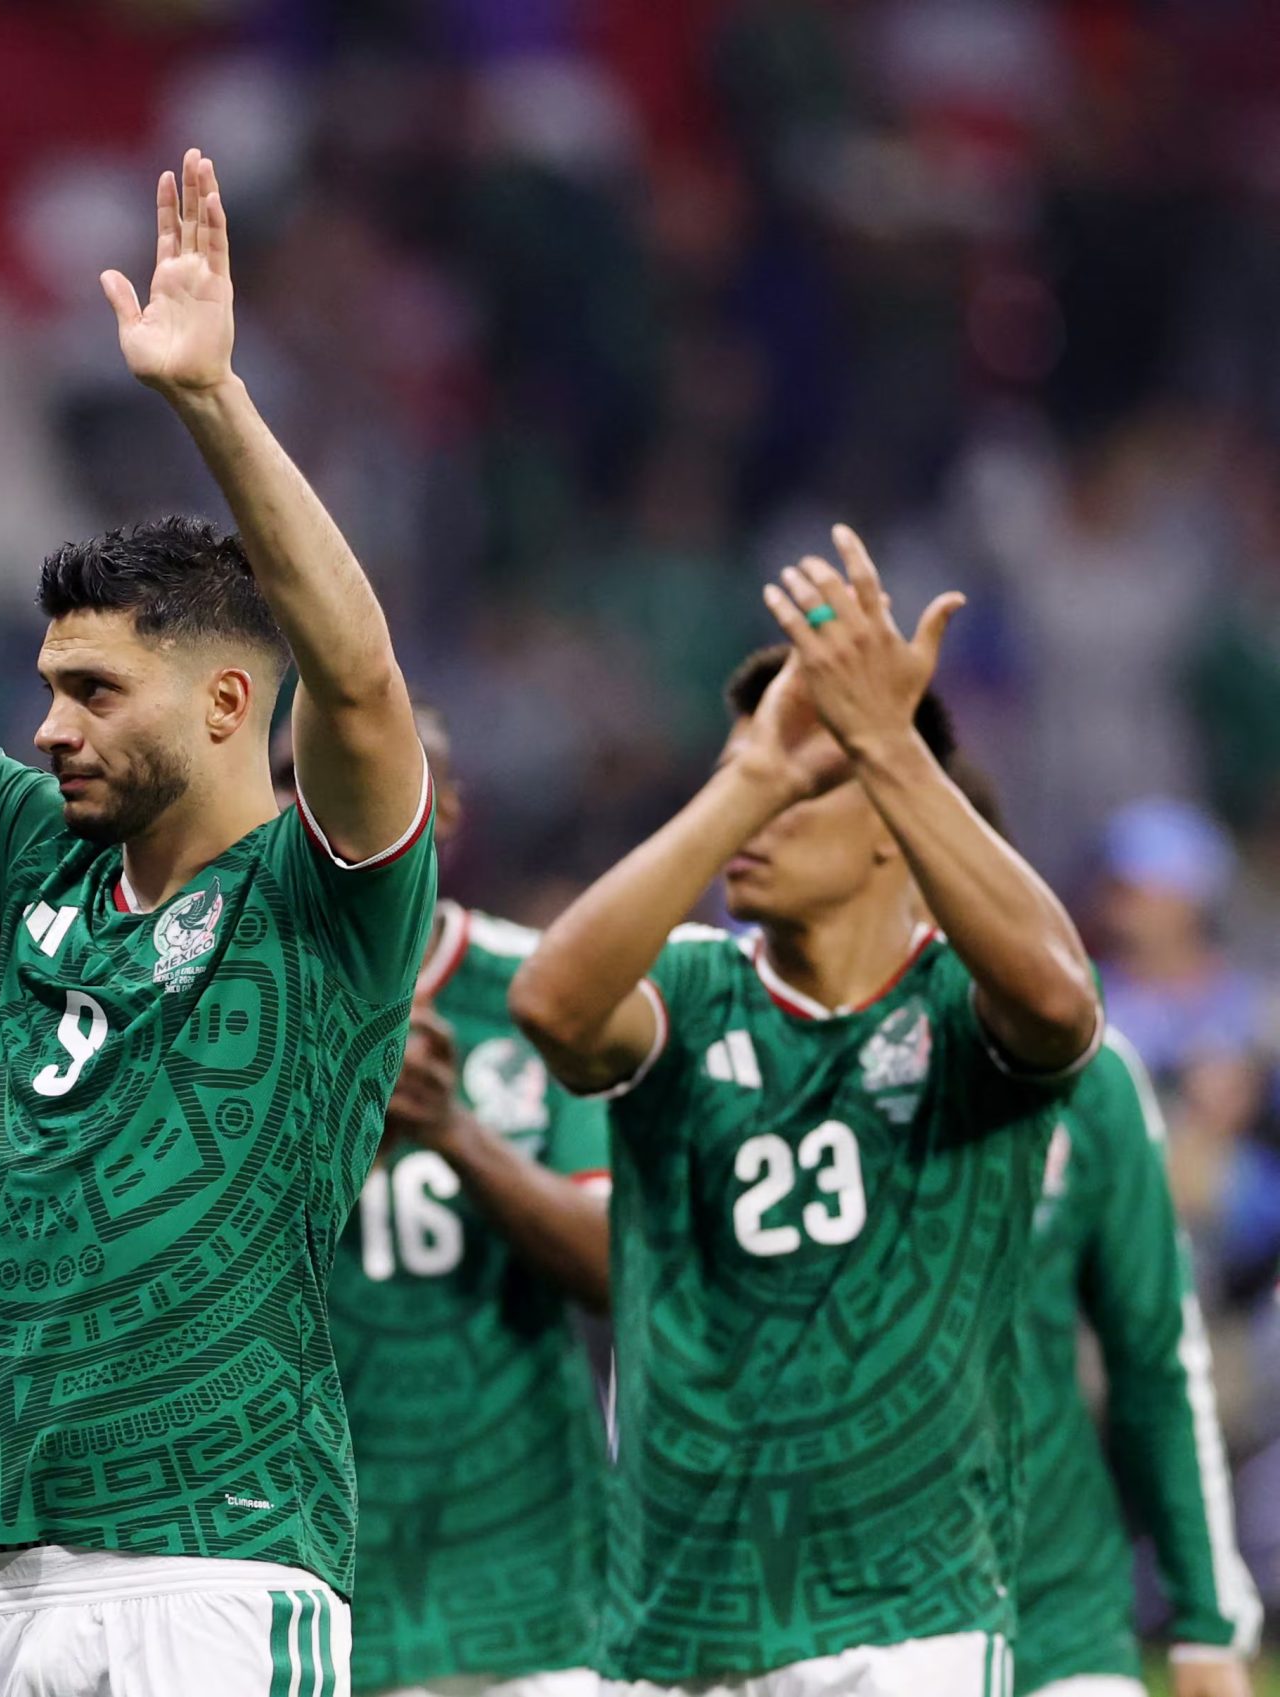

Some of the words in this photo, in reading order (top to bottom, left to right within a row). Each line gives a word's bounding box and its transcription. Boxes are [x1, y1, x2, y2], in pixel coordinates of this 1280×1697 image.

[32, 989, 109, 1097] 9
[360, 1150, 464, 1281] 16
[732, 1118, 867, 1257] 23
